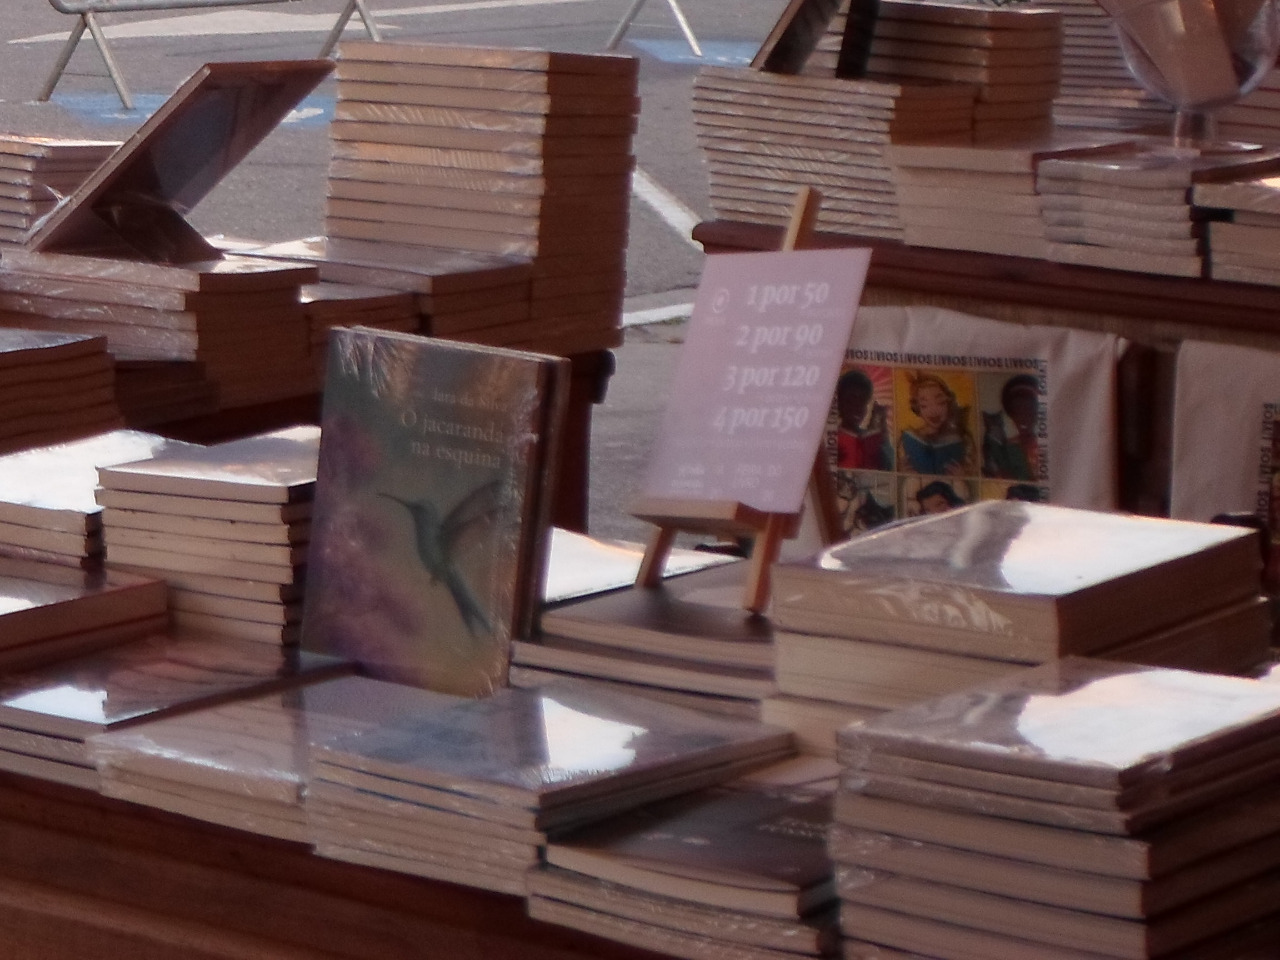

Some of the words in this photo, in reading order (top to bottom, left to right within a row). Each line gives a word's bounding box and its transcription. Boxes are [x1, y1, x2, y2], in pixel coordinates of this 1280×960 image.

[747, 284, 757, 307] 1
[758, 284, 800, 313] por
[800, 282, 830, 310] 50
[735, 324, 750, 346] 2
[750, 326, 793, 354] por
[793, 324, 824, 352] 90
[723, 365, 737, 392] 3
[737, 366, 782, 395] por
[782, 364, 821, 387] 120
[401, 409, 417, 428] O
[728, 407, 771, 435] por
[771, 406, 810, 434] 150
[411, 440, 430, 457] na
[435, 446, 501, 470] esquina
